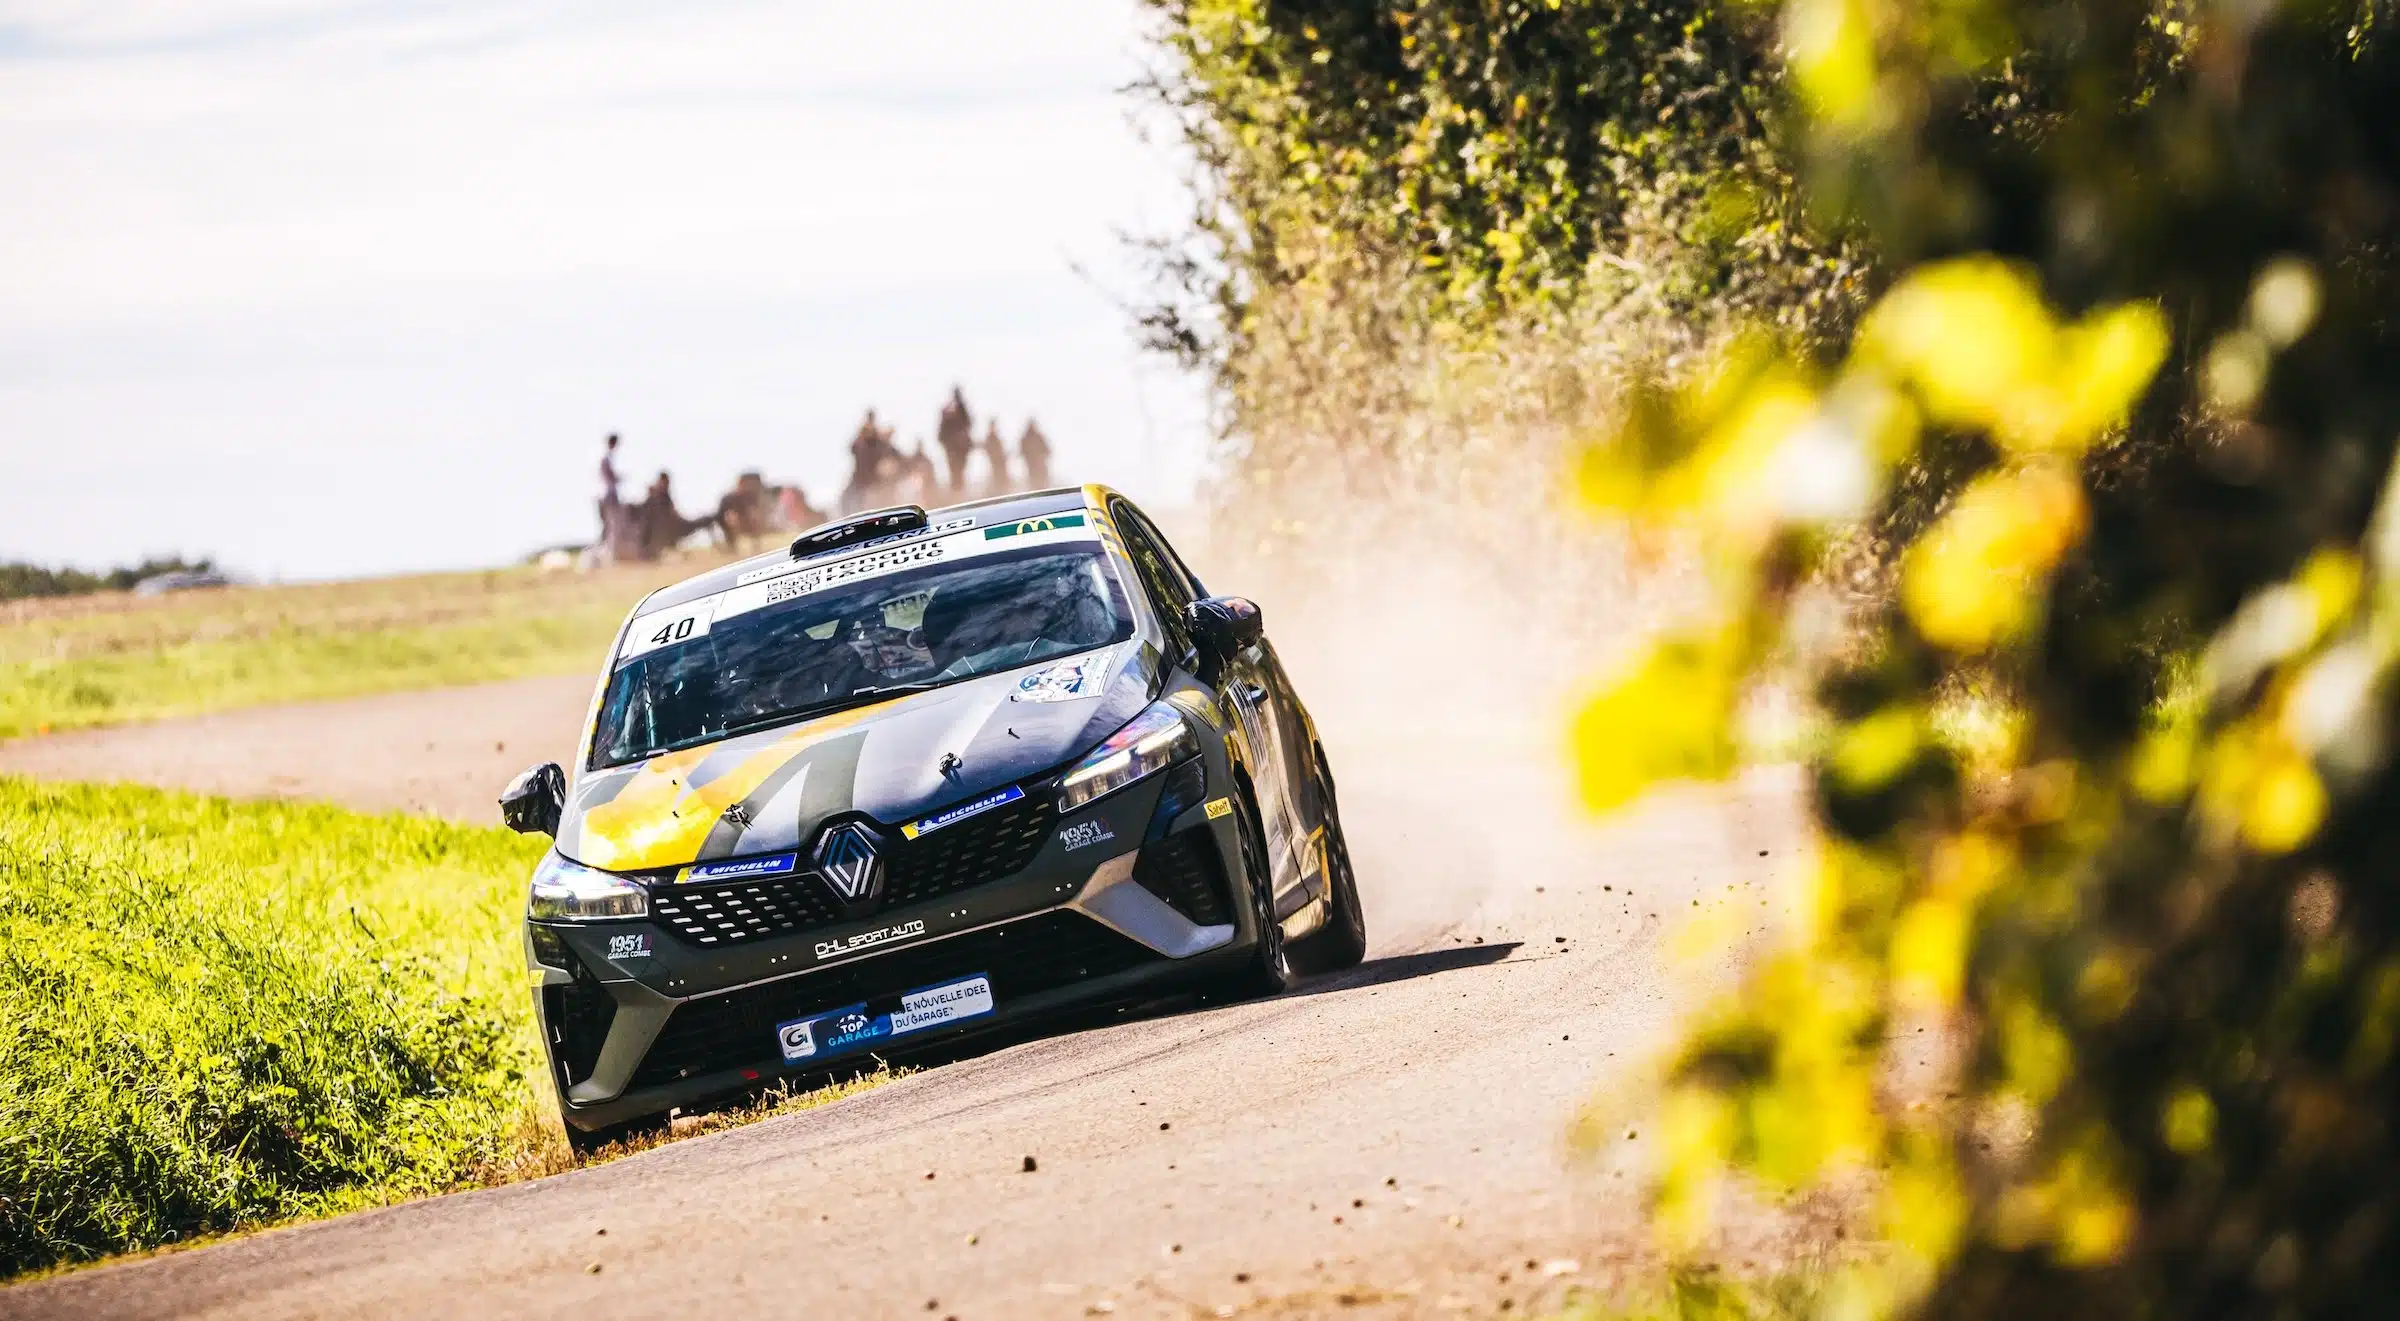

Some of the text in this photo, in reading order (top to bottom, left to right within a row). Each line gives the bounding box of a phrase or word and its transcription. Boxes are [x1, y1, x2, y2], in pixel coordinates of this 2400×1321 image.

[826, 540, 942, 573] renault
[651, 617, 695, 645] 40
[938, 793, 1008, 823] MICHELIN
[1060, 820, 1101, 845] 1951
[1065, 838, 1092, 852] GARAGE
[710, 860, 782, 875] MICHELIN
[609, 934, 644, 953] 1951
[814, 919, 925, 956] CHL SPORT AUTO
[607, 951, 630, 960] GARAGE
[914, 990, 964, 1011] NOUVELLE
[840, 1021, 864, 1034] TOP
[895, 1016, 910, 1029] DU
[828, 1026, 880, 1047] GARAGE
